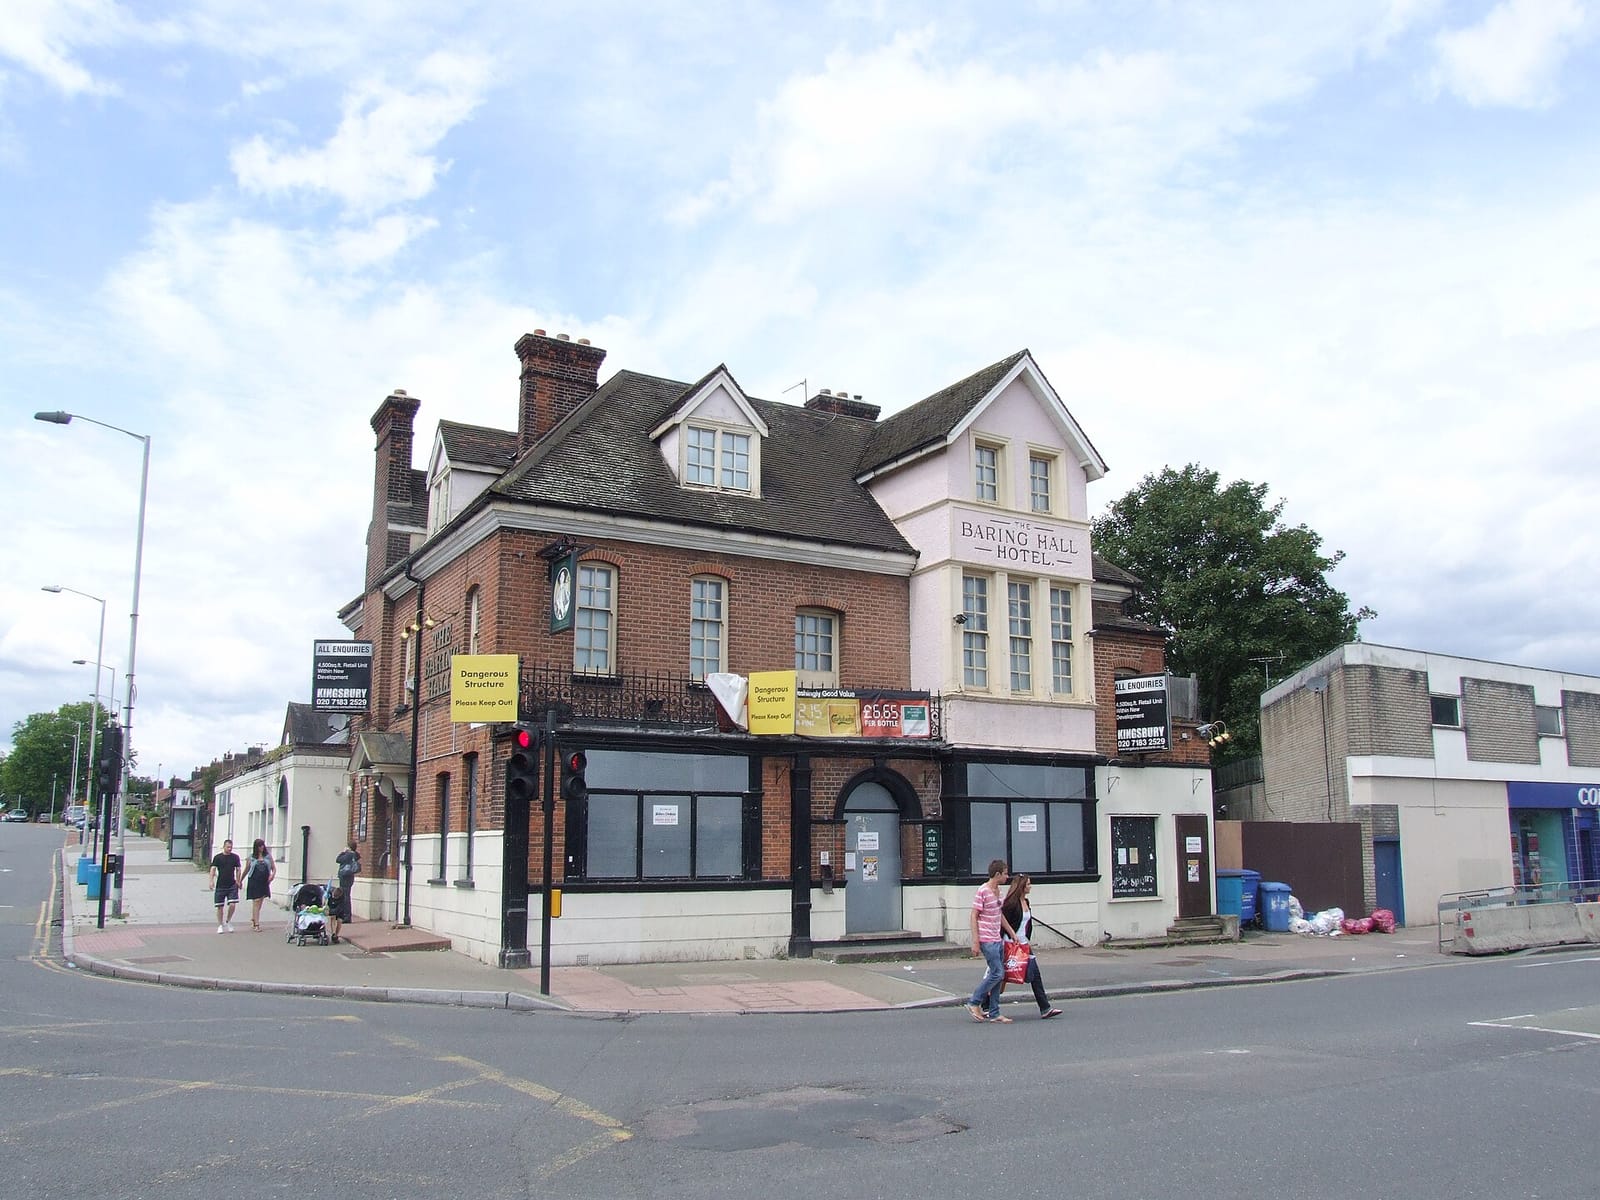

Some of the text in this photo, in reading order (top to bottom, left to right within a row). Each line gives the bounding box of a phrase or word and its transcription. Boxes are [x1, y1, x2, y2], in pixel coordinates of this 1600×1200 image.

[1015, 521, 1031, 530] THE
[962, 521, 1078, 554] BARING HALL
[997, 545, 1055, 566] HOTEL.
[432, 623, 453, 652] THE
[318, 645, 370, 654] ALL ENQUIRIES
[460, 670, 509, 680] Dangerous
[464, 680, 505, 688] Structure
[1115, 680, 1163, 691] ALL ENQUIRIES
[316, 688, 368, 698] KINGSBURY
[754, 686, 789, 694] Dangerous
[757, 695, 786, 703] Structure
[863, 704, 899, 719] £6.65
[1118, 727, 1164, 739] KINGSBURY
[1578, 788, 1600, 806] CO
